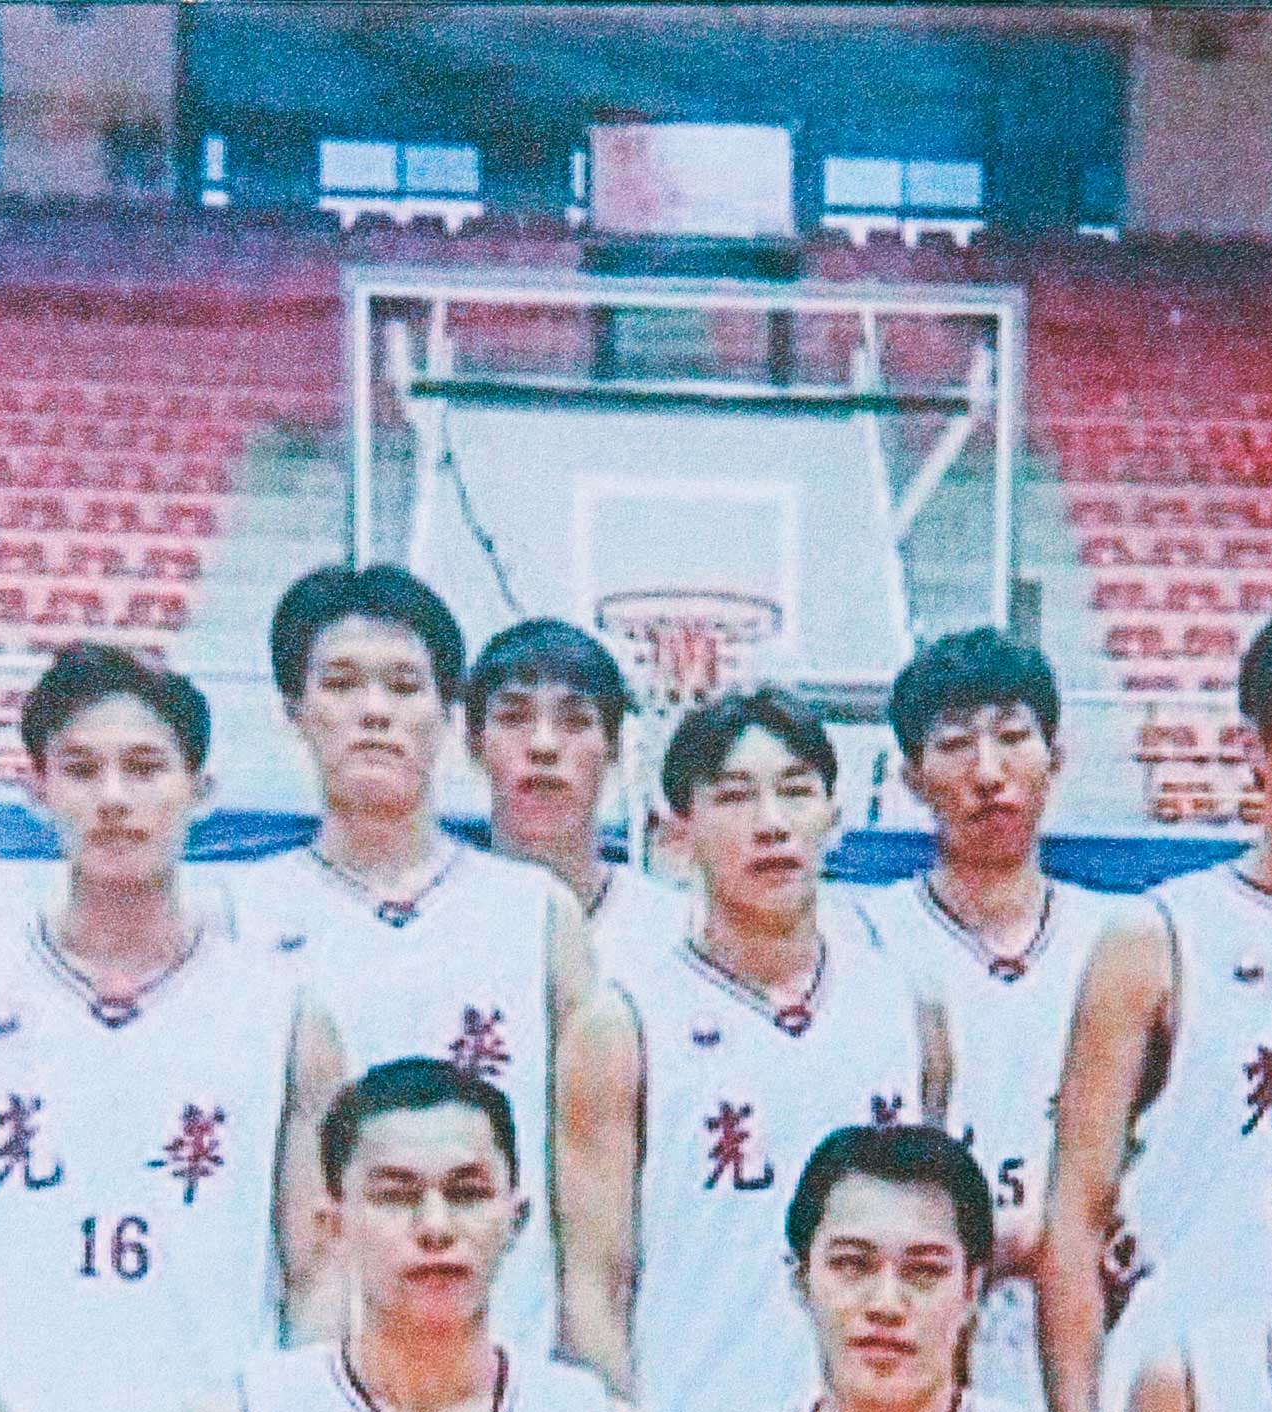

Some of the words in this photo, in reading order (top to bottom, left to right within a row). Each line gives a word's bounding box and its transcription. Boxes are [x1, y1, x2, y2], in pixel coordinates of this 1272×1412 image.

[145, 1104, 226, 1206] 華
[703, 1101, 773, 1192] 光
[78, 1215, 151, 1282] 16
